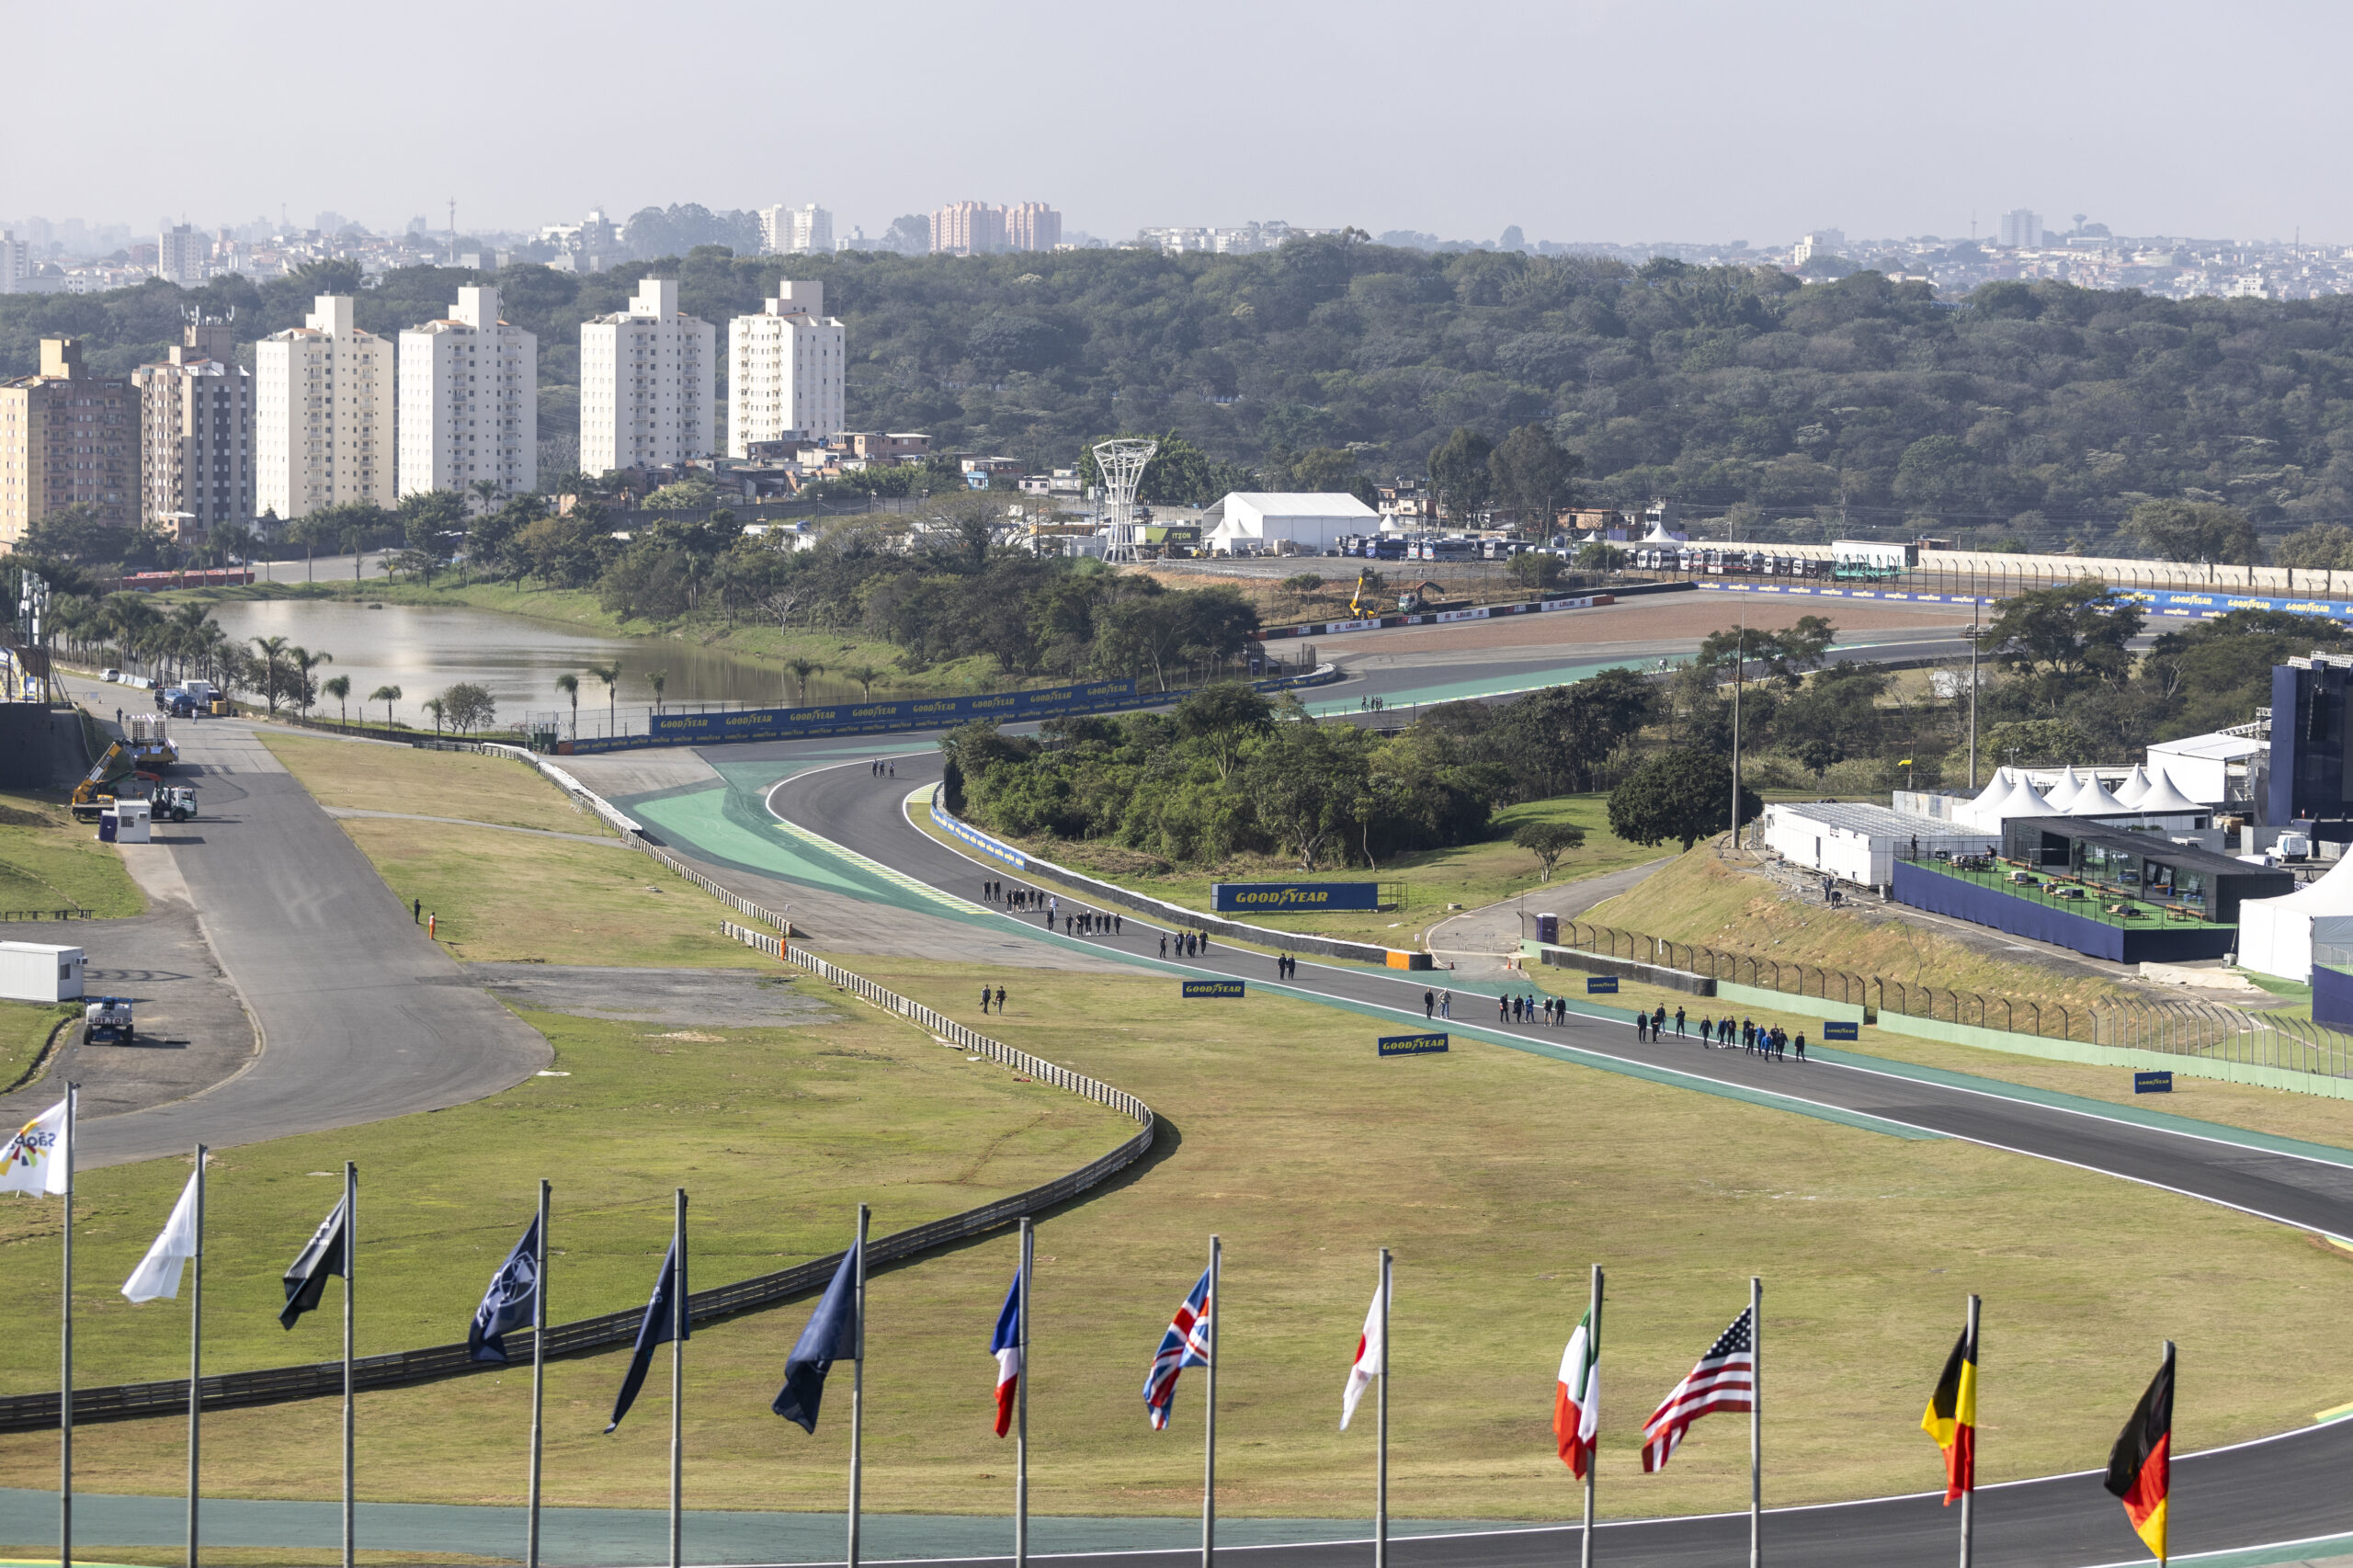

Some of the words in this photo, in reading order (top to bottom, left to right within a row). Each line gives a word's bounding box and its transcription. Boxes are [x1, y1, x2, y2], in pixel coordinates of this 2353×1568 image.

[2170, 594, 2213, 606] GOODYEAR
[2227, 598, 2271, 610] GOODYEAR
[2285, 602, 2330, 613] GOODYEAR
[1086, 683, 1128, 696] GOODYEAR
[1030, 690, 1073, 703] GOODYEAR
[913, 701, 956, 713] GOODYEAR
[972, 697, 1015, 709] GOODYEAR
[790, 709, 835, 722] GOODYEAR
[852, 705, 897, 718] GOODYEAR
[660, 717, 708, 729] GOODYEAR
[725, 713, 773, 726] GOODYEAR
[1235, 888, 1329, 906] GOODYEAR
[1186, 983, 1242, 994] GOODYEAR
[1382, 1038, 1446, 1051] GOODYEAR
